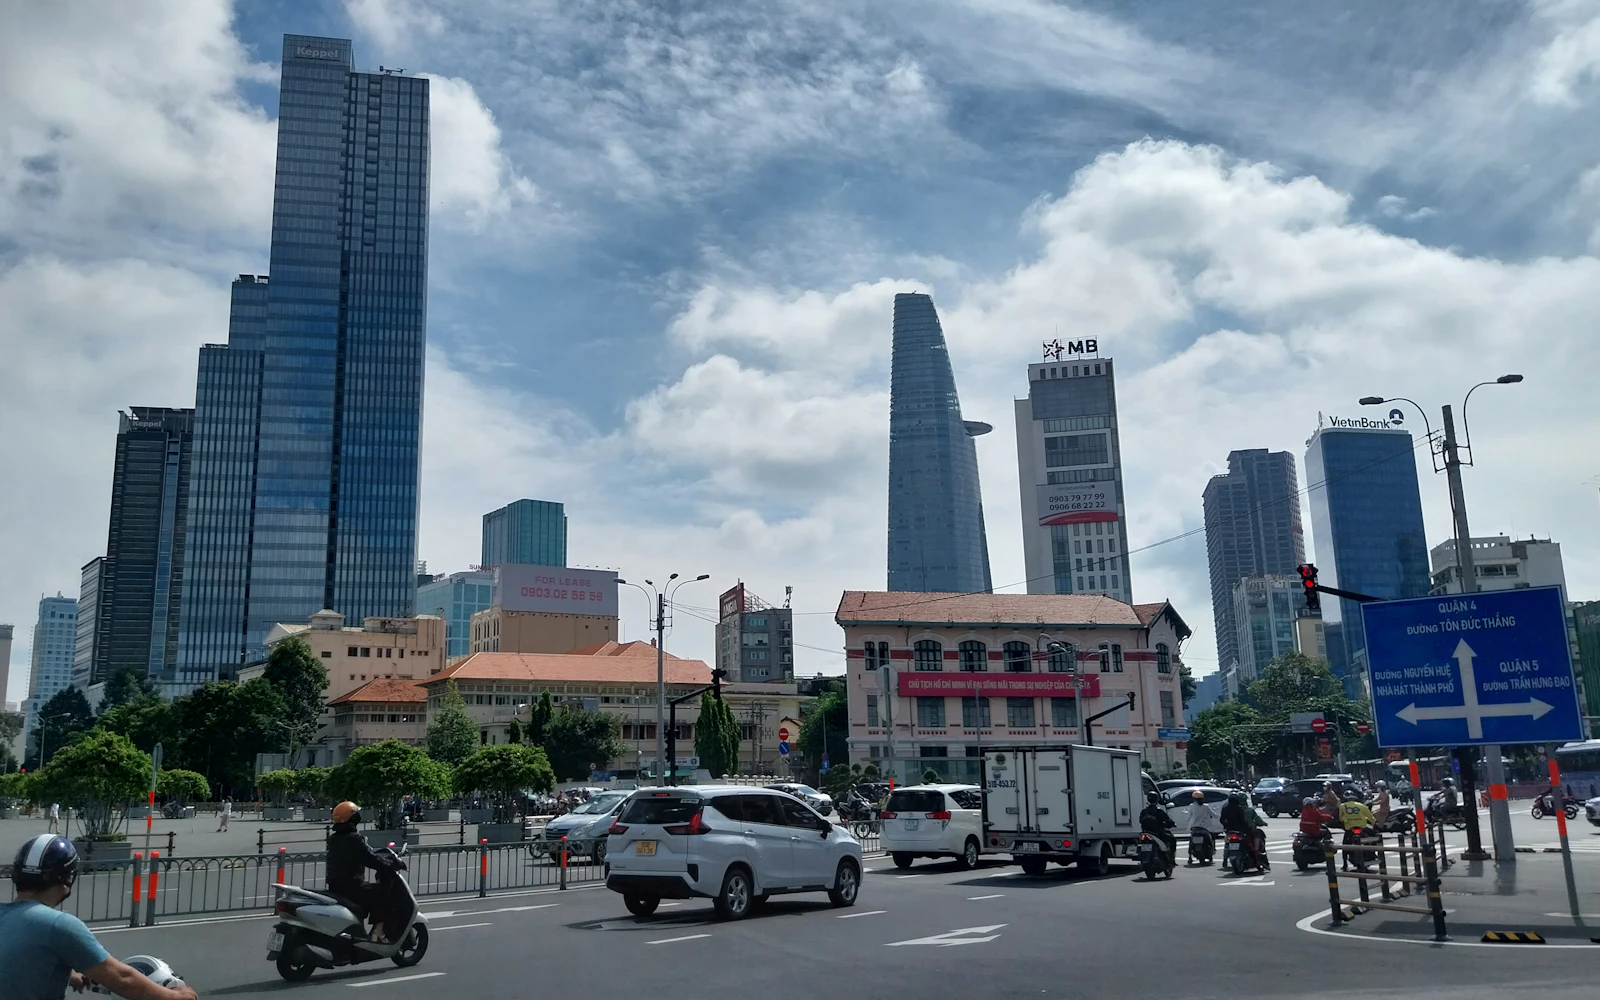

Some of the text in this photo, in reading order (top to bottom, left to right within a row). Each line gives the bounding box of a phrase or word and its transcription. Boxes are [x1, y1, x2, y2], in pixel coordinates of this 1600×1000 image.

[296, 47, 339, 58] Keppel
[1068, 340, 1097, 354] MB
[132, 420, 162, 428] Keppel
[1329, 416, 1390, 429] VietinBank
[1049, 495, 1069, 503] 0903
[1083, 493, 1093, 501] 77
[1095, 492, 1105, 500] 99
[1049, 503, 1070, 511] 0906
[535, 576, 592, 587] FOR LEASE
[521, 587, 603, 602] 0903.02 58 58
[1438, 599, 1477, 614] QUẬN 4
[1407, 612, 1516, 635] ĐƯỜNG TÔN ĐỨC THẮNG
[1375, 669, 1402, 680] ĐƯỜNG
[1436, 663, 1451, 678] HUỆ
[1500, 659, 1539, 674] QUẬN 5
[1009, 681, 1026, 689] TRONG
[1377, 678, 1454, 696] NHÀ HÁT THÀNH PHỐ
[1483, 680, 1508, 691] ĐƯỜNG
[1531, 677, 1553, 688] HƯNG
[1554, 676, 1570, 690] ĐẠO
[1345, 804, 1360, 815] be
